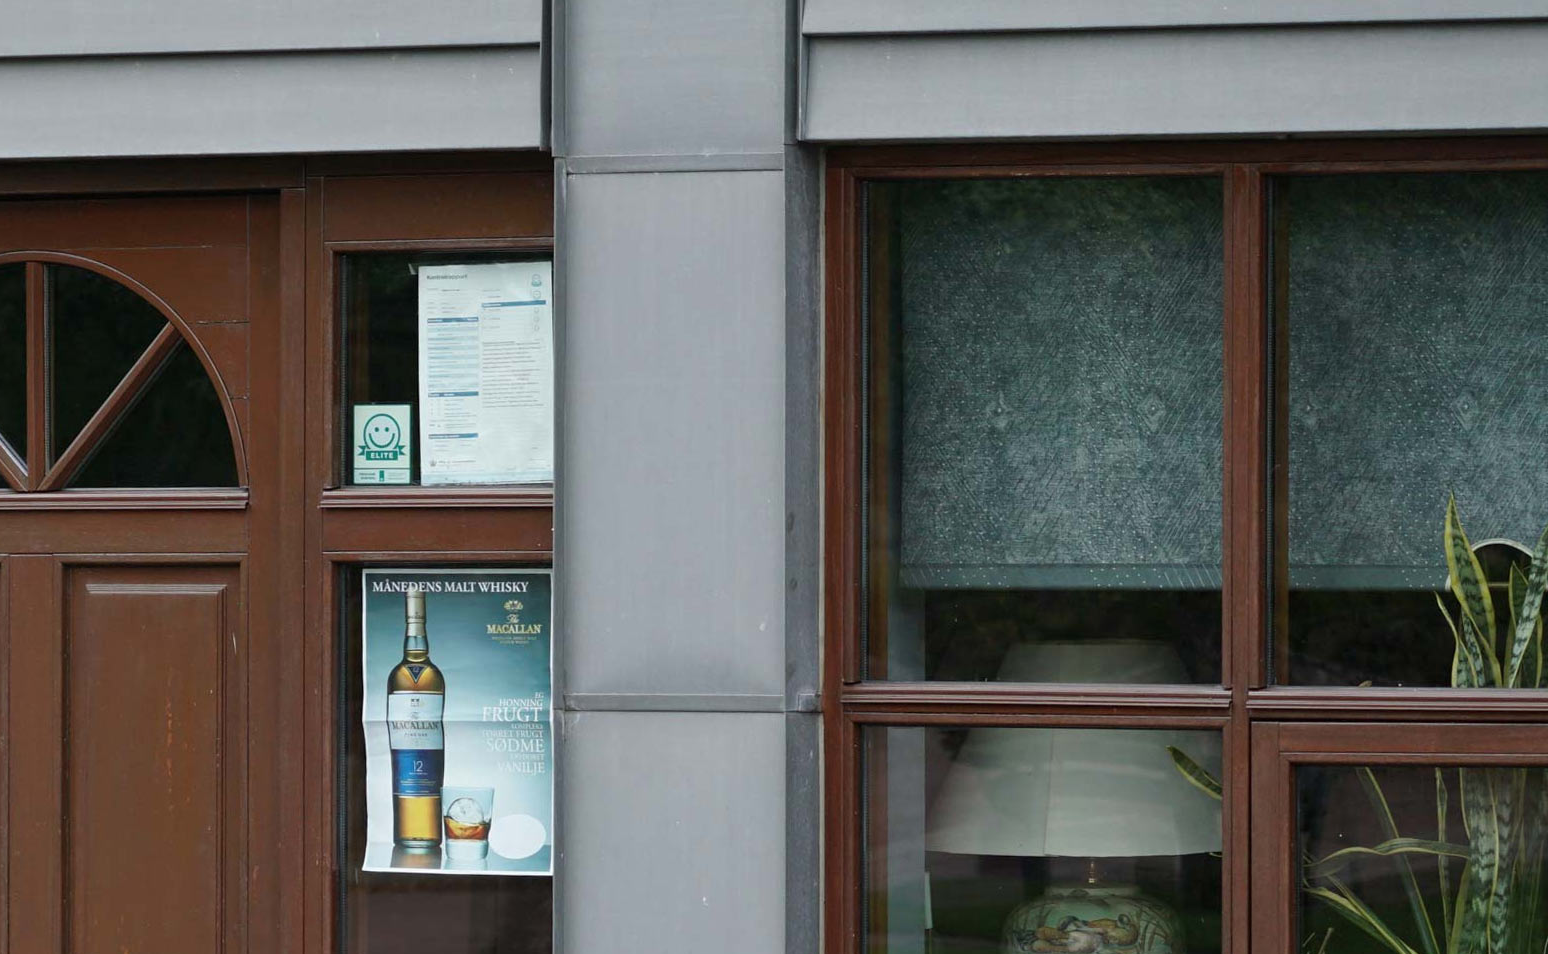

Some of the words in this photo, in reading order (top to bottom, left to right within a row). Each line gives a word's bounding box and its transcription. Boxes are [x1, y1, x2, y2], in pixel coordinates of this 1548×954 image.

[372, 579, 442, 593] MÅNEDENS
[444, 581, 477, 593] MALT
[478, 581, 529, 593] WHISKY
[486, 624, 542, 634] MACALLAN
[499, 699, 543, 707] HONNING
[482, 707, 543, 722] FRUGT
[392, 721, 440, 730] MACALLAN
[516, 730, 543, 738] FRUGT
[486, 738, 545, 753] SØDME
[413, 760, 423, 772] 12
[497, 761, 546, 776] VANILJE
